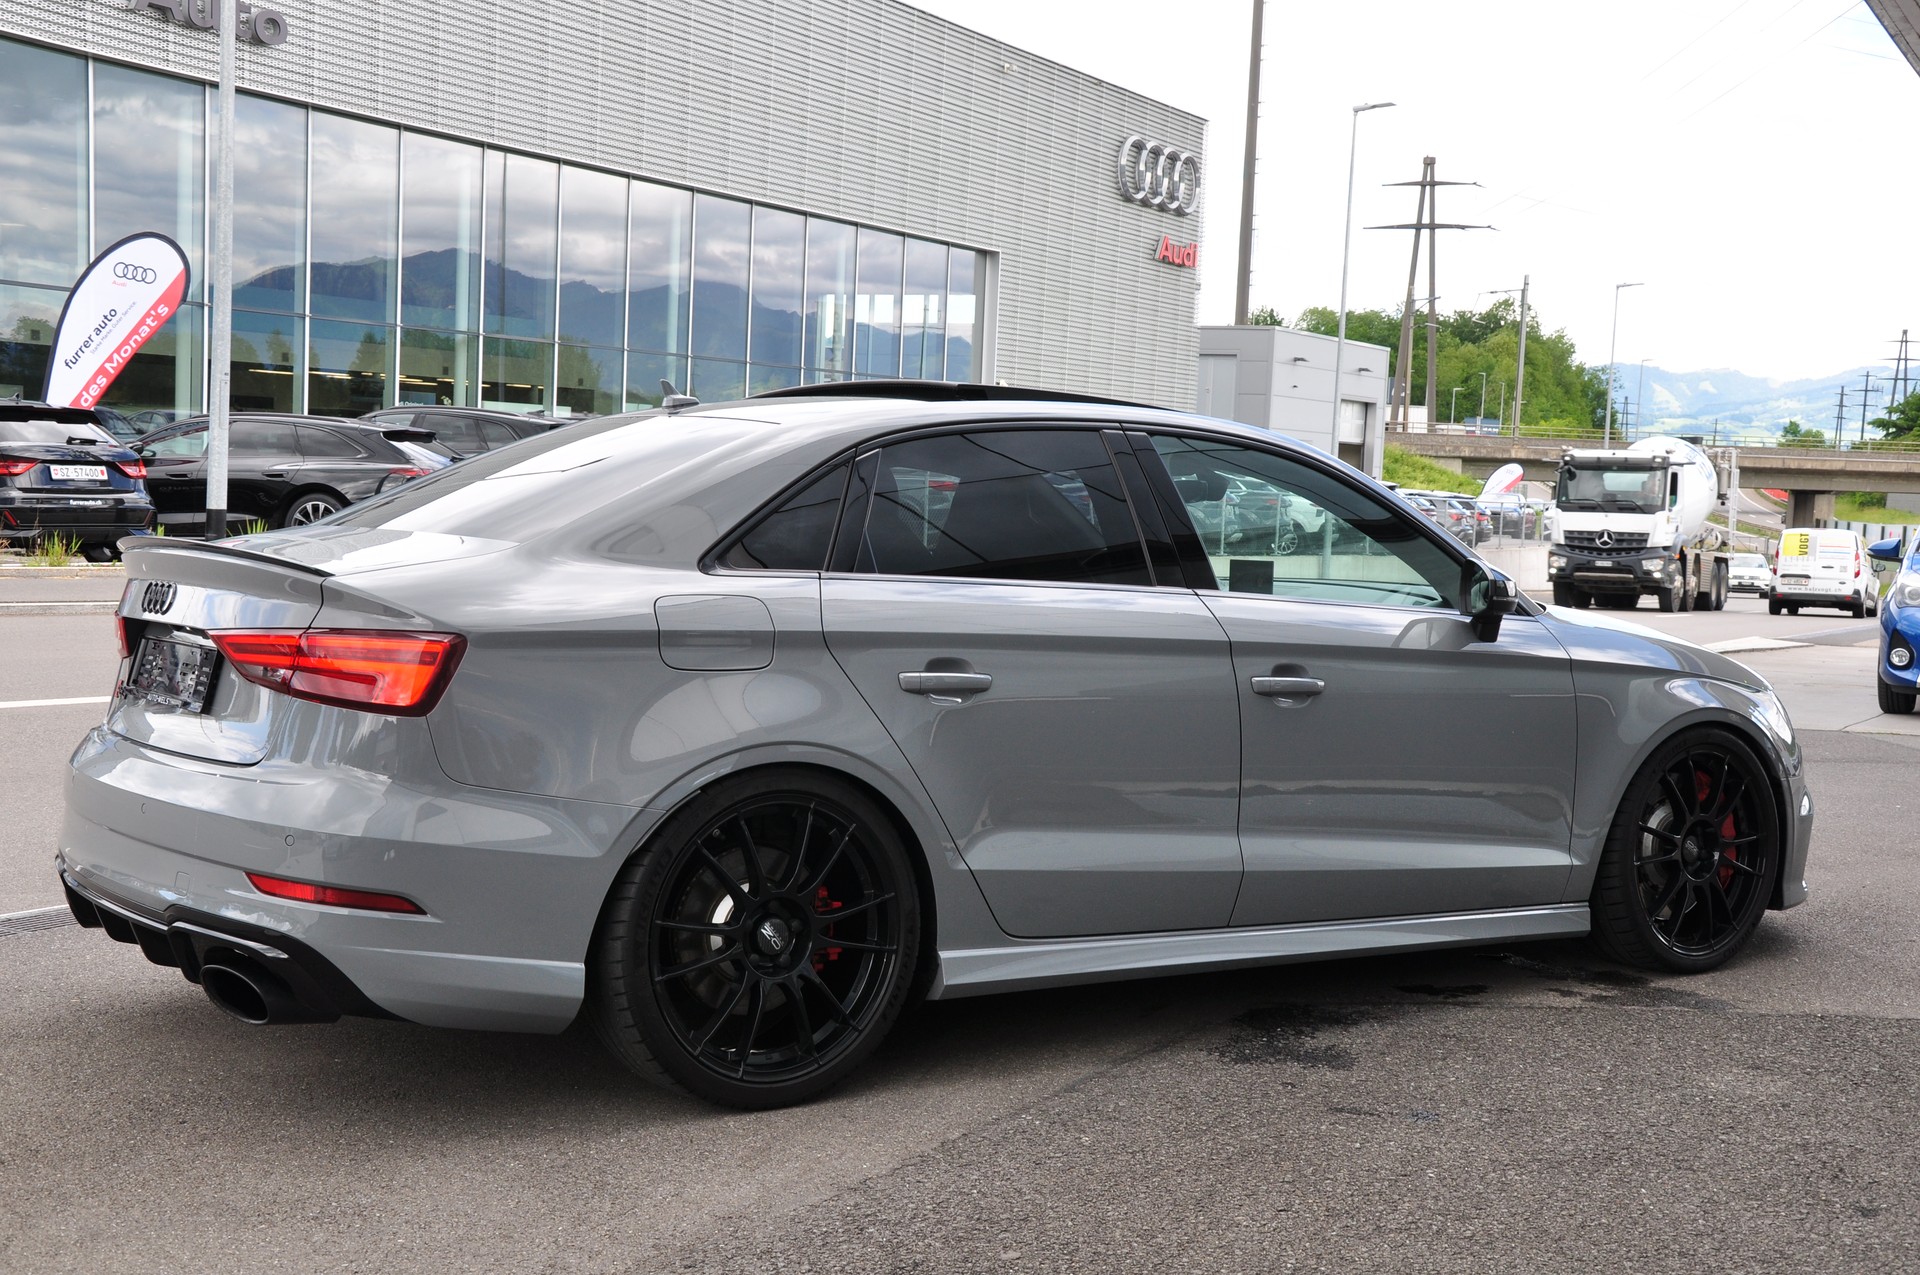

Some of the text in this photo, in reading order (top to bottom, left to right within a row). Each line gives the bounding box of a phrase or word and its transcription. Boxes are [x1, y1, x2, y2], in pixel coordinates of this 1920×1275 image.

[1156, 235, 1199, 268] Audi
[64, 308, 118, 370] furrer auto
[80, 303, 169, 408] des Monat's
[1798, 533, 1809, 556] VOGT
